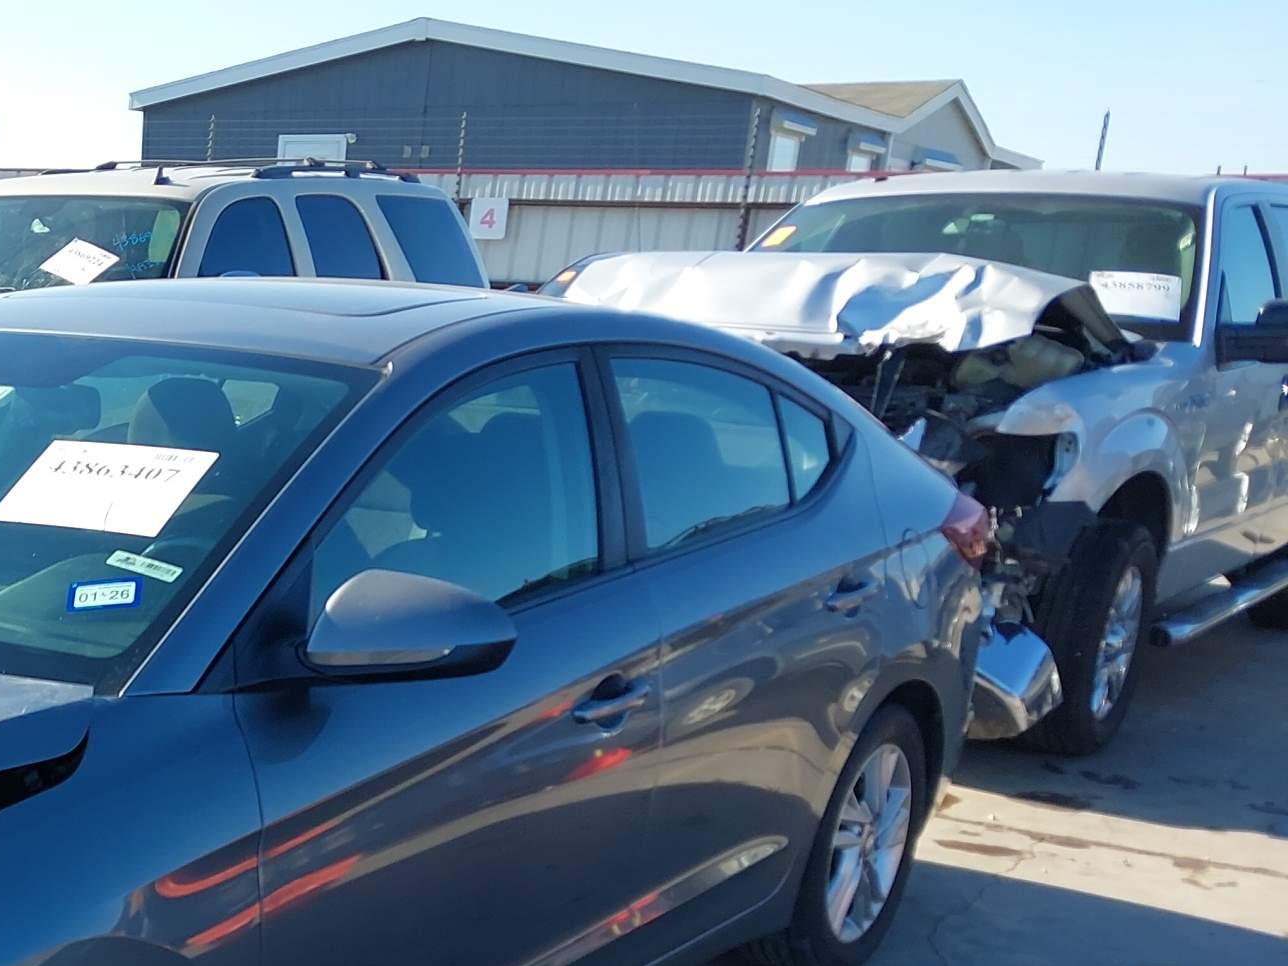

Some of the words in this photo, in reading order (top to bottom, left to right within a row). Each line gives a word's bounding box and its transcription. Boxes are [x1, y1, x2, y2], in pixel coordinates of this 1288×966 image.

[479, 207, 497, 229] 4
[49, 459, 181, 483] 43863407
[78, 591, 99, 604] 01
[109, 588, 130, 601] 26
